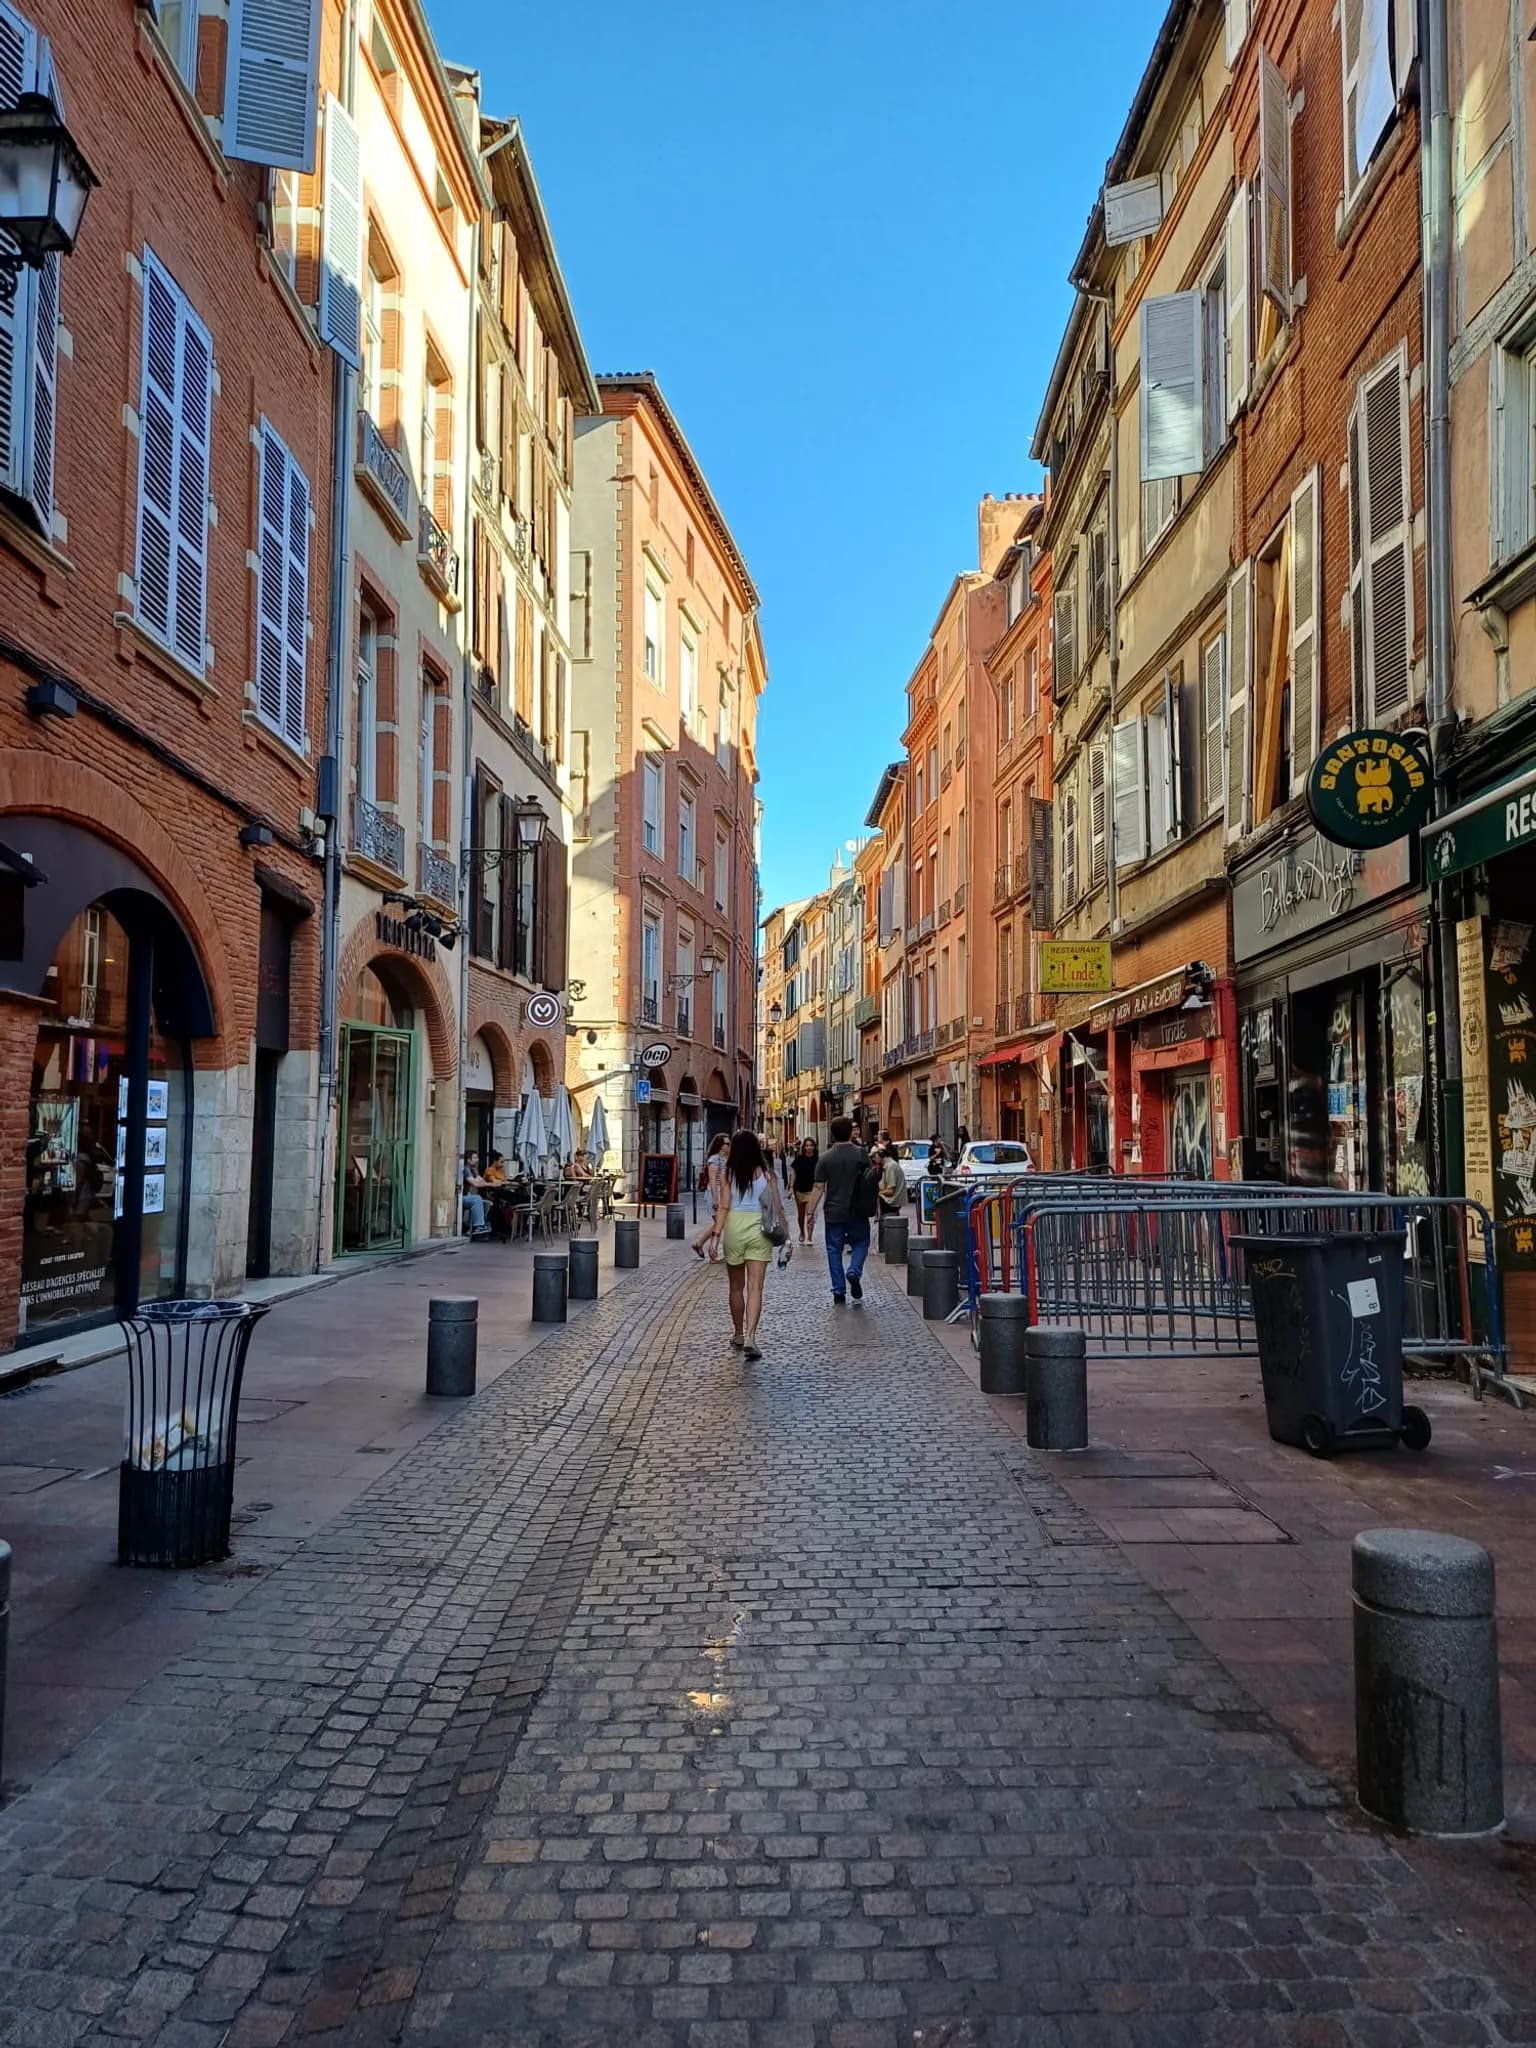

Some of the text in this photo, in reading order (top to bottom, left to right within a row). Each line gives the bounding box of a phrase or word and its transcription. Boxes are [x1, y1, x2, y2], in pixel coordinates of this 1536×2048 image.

[1320, 738, 1424, 790] SANTOSHA
[1257, 856, 1293, 935] Bello
[1050, 946, 1101, 954] RESTAURANT
[644, 1050, 668, 1061] OCD
